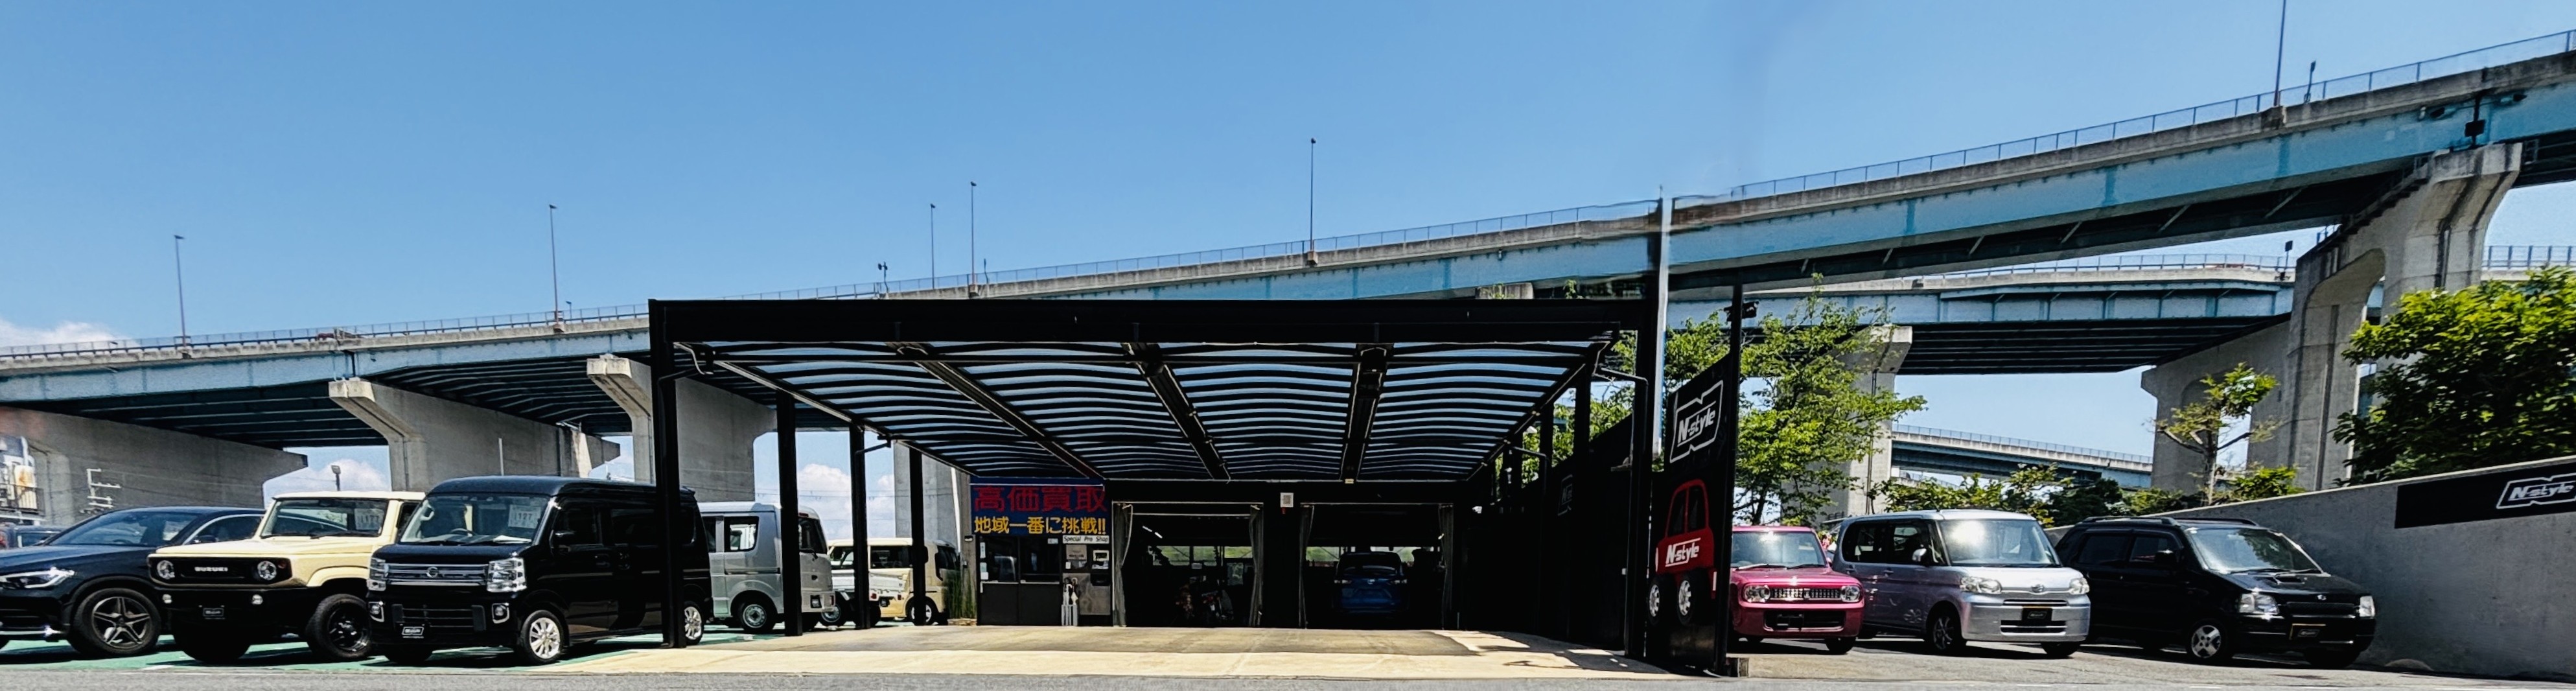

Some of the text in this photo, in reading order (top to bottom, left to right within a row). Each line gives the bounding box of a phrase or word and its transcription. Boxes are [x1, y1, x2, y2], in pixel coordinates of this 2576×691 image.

[974, 487, 1108, 512] 高価買取
[974, 516, 1106, 535] 地域一番に挑戦!!
